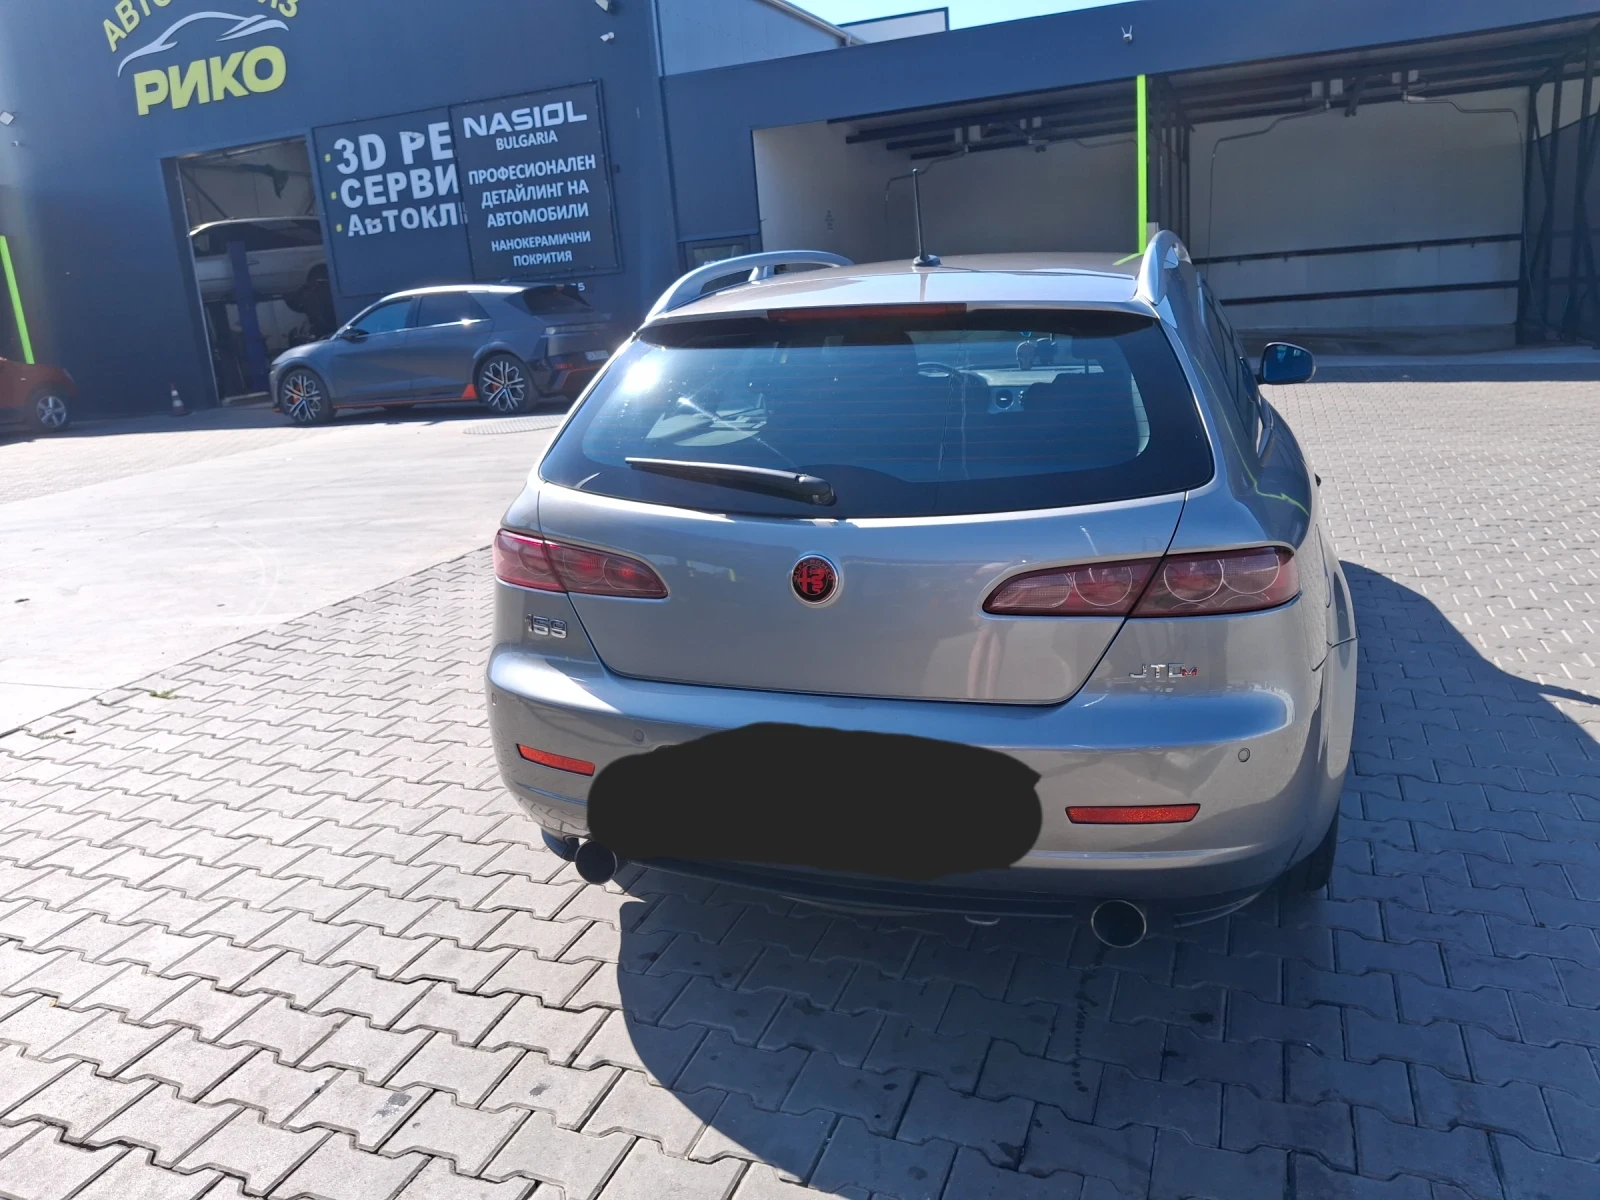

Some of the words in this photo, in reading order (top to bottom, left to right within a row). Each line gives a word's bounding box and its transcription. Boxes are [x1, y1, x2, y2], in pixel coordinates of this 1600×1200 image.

[133, 45, 286, 116] РИКО
[463, 101, 588, 138] NASIOL
[334, 133, 386, 174] 3D
[496, 130, 559, 151] BULGARIA
[468, 154, 597, 185] ПРОФЕСИОНАЛЕН
[340, 163, 459, 209] СЕРВИ
[481, 184, 564, 209] ДЕТАЙЛИНГ
[567, 179, 590, 196] НА
[487, 202, 589, 228] АВТОМОБИЛИ
[491, 231, 591, 252] НАНОКЕРАМИЧНИ
[513, 250, 573, 267] ПОКРИТИЯ
[525, 613, 568, 639] 159
